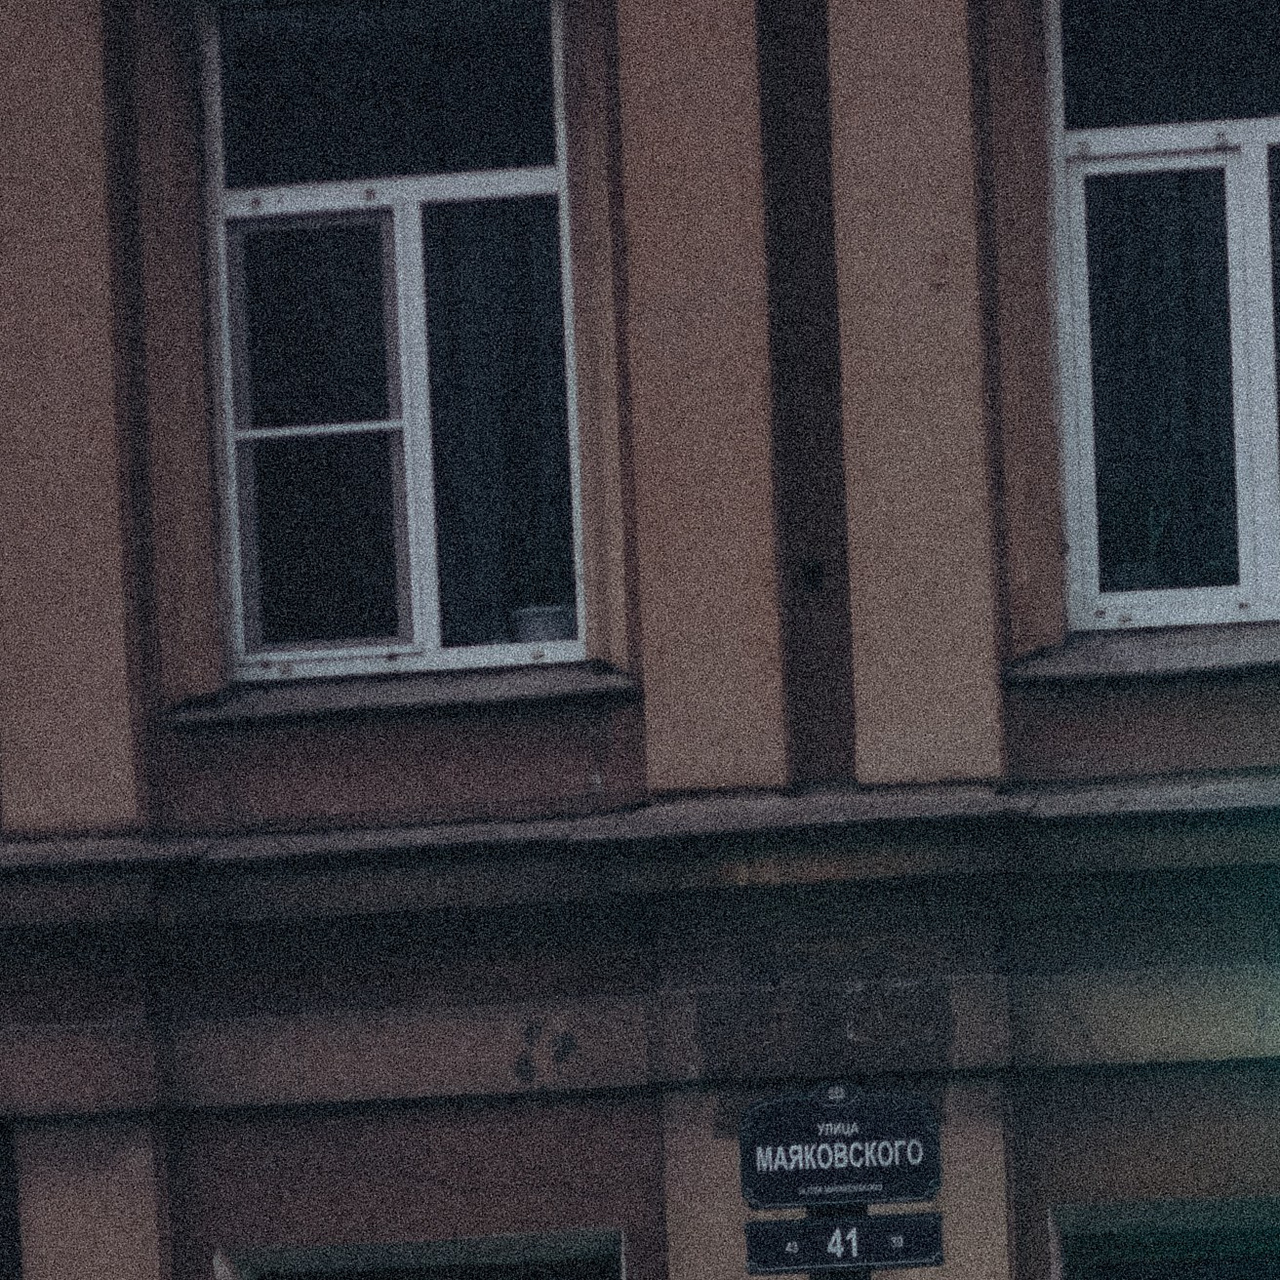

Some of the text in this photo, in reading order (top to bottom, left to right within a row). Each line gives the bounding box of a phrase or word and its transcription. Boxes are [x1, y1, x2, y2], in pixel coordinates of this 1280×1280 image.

[816, 1122, 859, 1137] УЛИЦА
[755, 1139, 924, 1172] МАЯКОВСКОГО
[826, 1226, 860, 1259] 41
